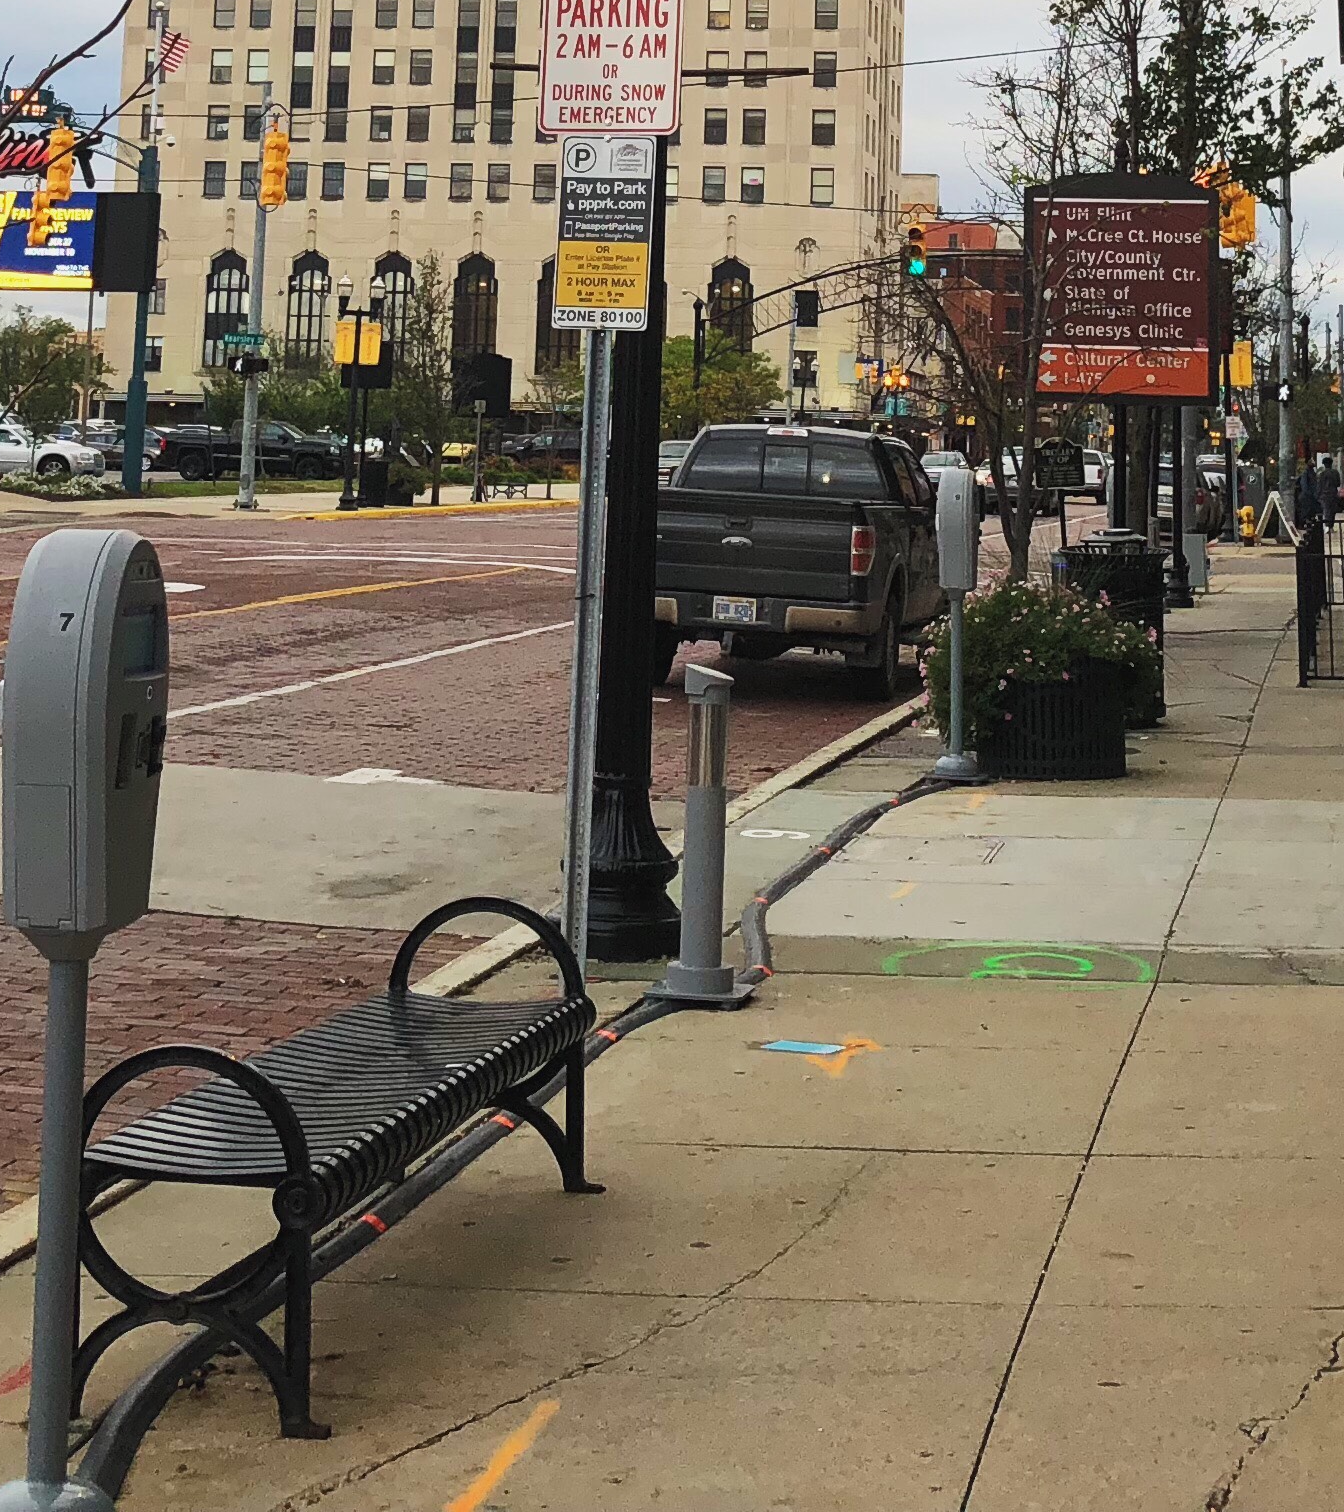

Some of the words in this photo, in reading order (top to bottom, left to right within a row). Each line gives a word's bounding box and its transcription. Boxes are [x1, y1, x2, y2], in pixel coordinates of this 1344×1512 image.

[602, 64, 618, 79] OR
[552, 84, 613, 101] DURING
[620, 84, 666, 101] SNOW
[558, 106, 657, 124] EMERGENCY
[566, 180, 593, 196] Pay
[596, 181, 610, 195] to
[613, 181, 647, 195] Park
[578, 197, 646, 212] ppprk.com
[1066, 207, 1090, 221] UM
[1097, 206, 1132, 222] Flint
[1066, 228, 1124, 242] McCree
[1128, 229, 1149, 243] Ct.
[1152, 230, 1202, 244] House
[596, 245, 610, 254] OR
[1066, 249, 1162, 268] City/County
[566, 276, 573, 287] 2
[575, 277, 609, 287] HOUR
[611, 277, 636, 288] MAX
[1172, 268, 1201, 282] Ctr.
[1064, 285, 1106, 299] State
[1113, 285, 1130, 300] of
[556, 309, 597, 323] ZONE
[600, 310, 643, 324] 80100
[1143, 302, 1192, 318] Office
[1064, 322, 1132, 341] Genesys
[1138, 324, 1184, 339] Clinic
[1064, 352, 1129, 367] Cultural
[1136, 353, 1192, 369] Center
[59, 612, 75, 632] 7
